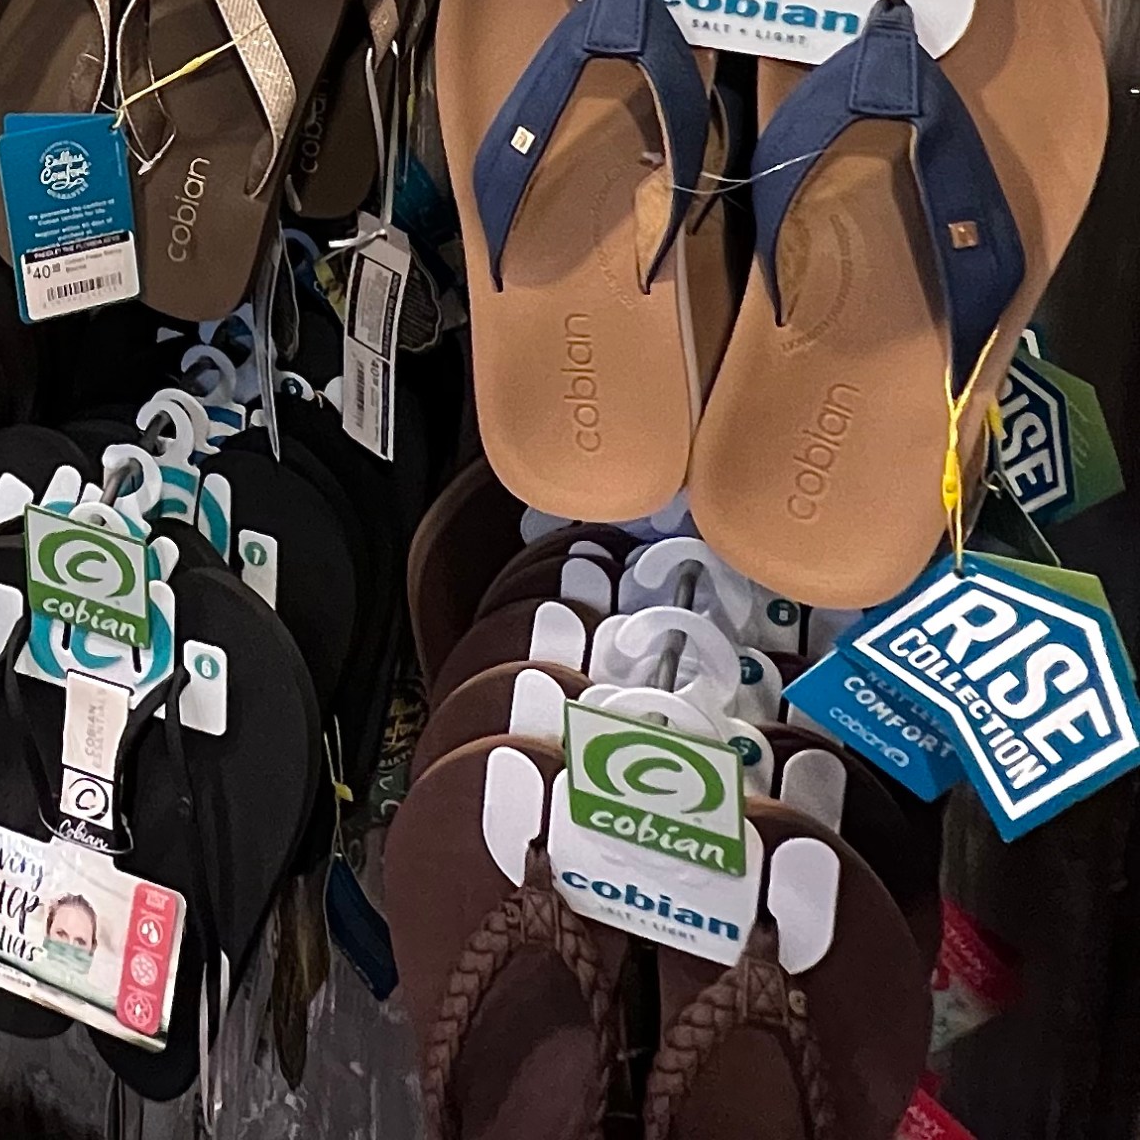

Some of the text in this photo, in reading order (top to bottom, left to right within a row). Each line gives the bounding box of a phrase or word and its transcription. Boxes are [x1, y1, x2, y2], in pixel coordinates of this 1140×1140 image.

[692, 18, 809, 45] SALT LIGHT
[167, 156, 212, 263] cobian
[564, 312, 602, 454] cobian
[787, 382, 860, 522] cobian
[43, 597, 138, 641] cobian
[888, 627, 1048, 790] COLLECTION
[922, 588, 1112, 765] RISE
[829, 707, 890, 756] cobian
[843, 676, 955, 759] COMFORT
[59, 819, 109, 850] Cobian
[590, 806, 726, 866] cobian
[561, 868, 740, 942] cobian
